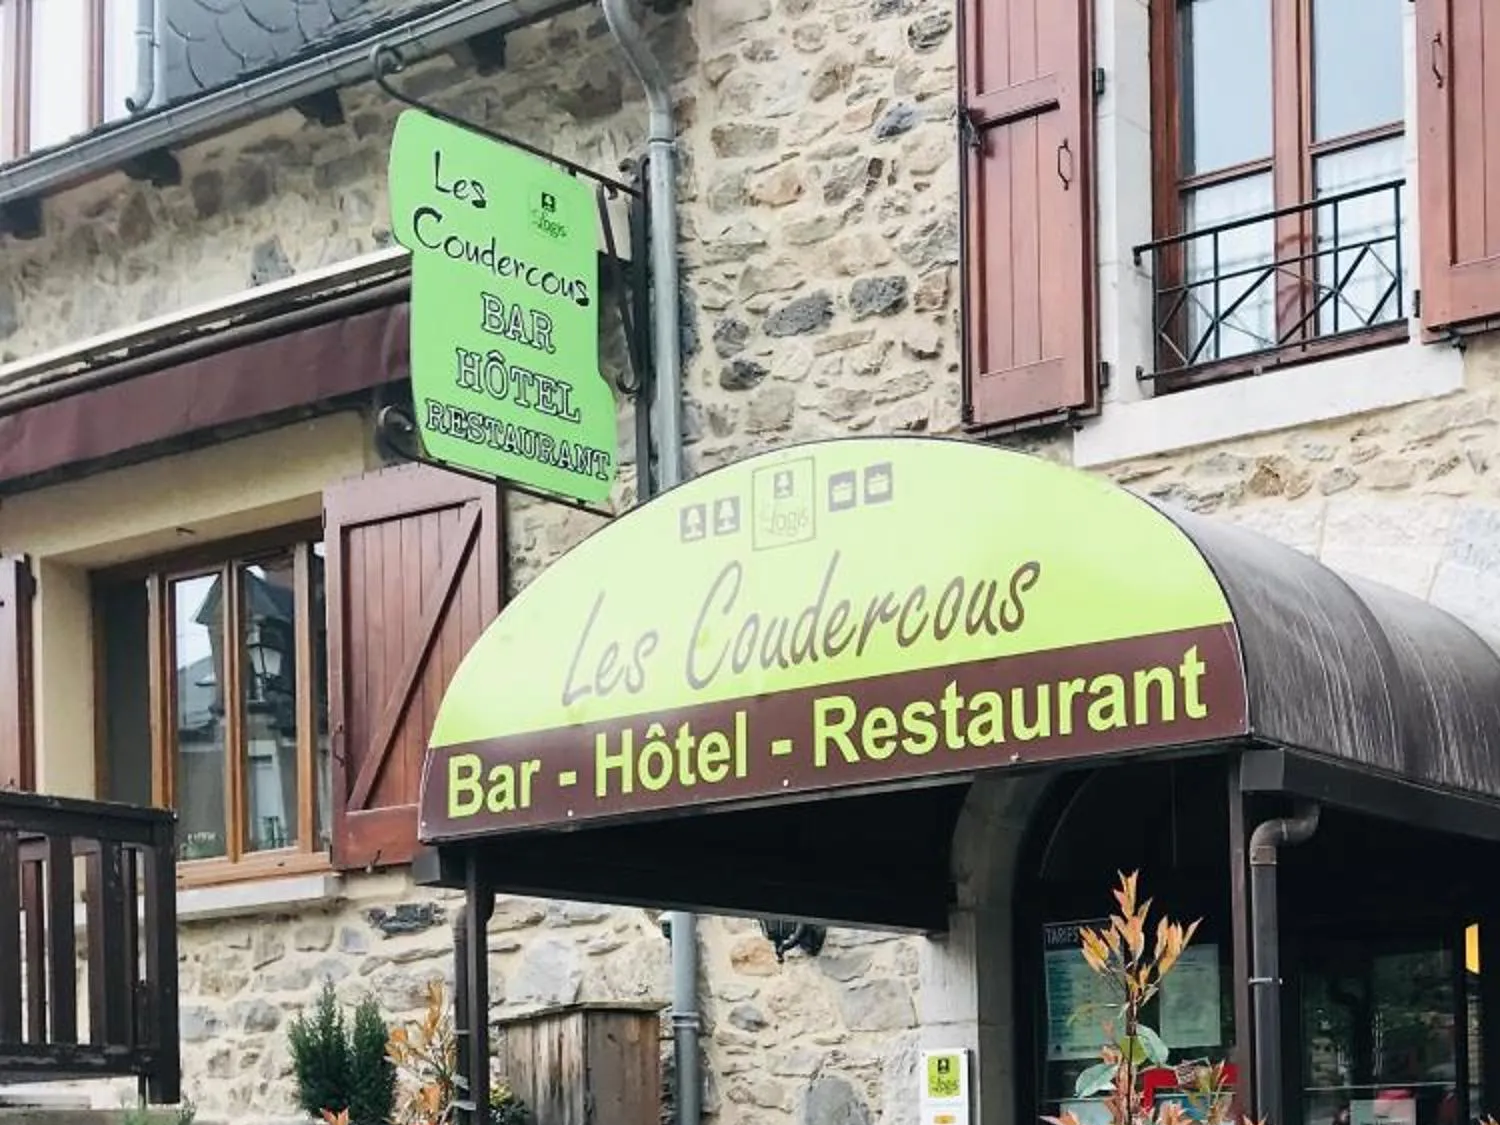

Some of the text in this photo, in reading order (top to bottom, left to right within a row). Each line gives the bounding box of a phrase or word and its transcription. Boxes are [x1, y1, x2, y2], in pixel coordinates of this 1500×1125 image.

[433, 150, 488, 209] Les
[412, 206, 591, 307] Coudercous
[480, 291, 557, 354] BAR
[456, 347, 581, 423] HÔTEL
[424, 399, 611, 480] RESTAURANT
[561, 550, 1042, 708] Les Coudercous
[447, 755, 540, 818] Bar
[594, 728, 749, 798] Hôtel
[813, 644, 1208, 768] Restaurant
